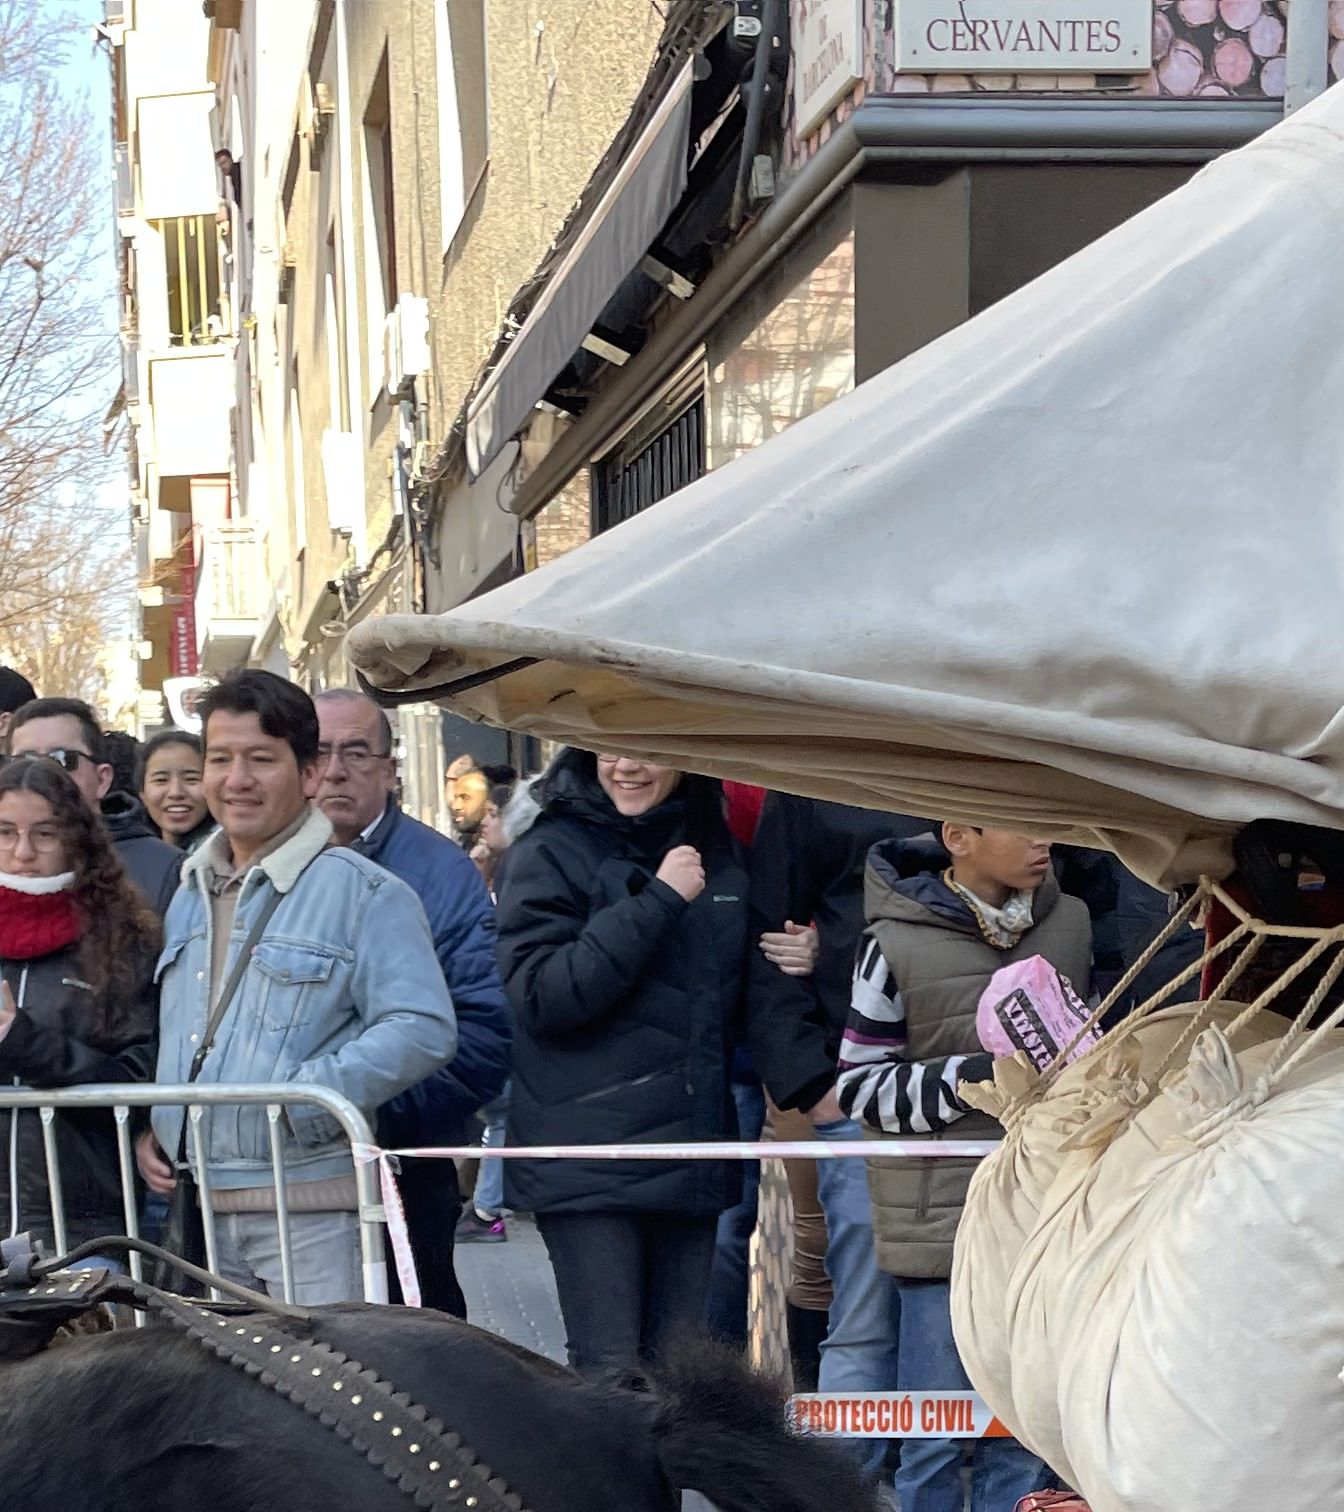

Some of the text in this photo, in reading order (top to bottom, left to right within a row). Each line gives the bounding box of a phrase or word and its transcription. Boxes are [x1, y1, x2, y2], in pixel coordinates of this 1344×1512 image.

[926, 18, 1121, 53] CERVANTES
[794, 1394, 976, 1433] PROTECCIÓ CIVIL
